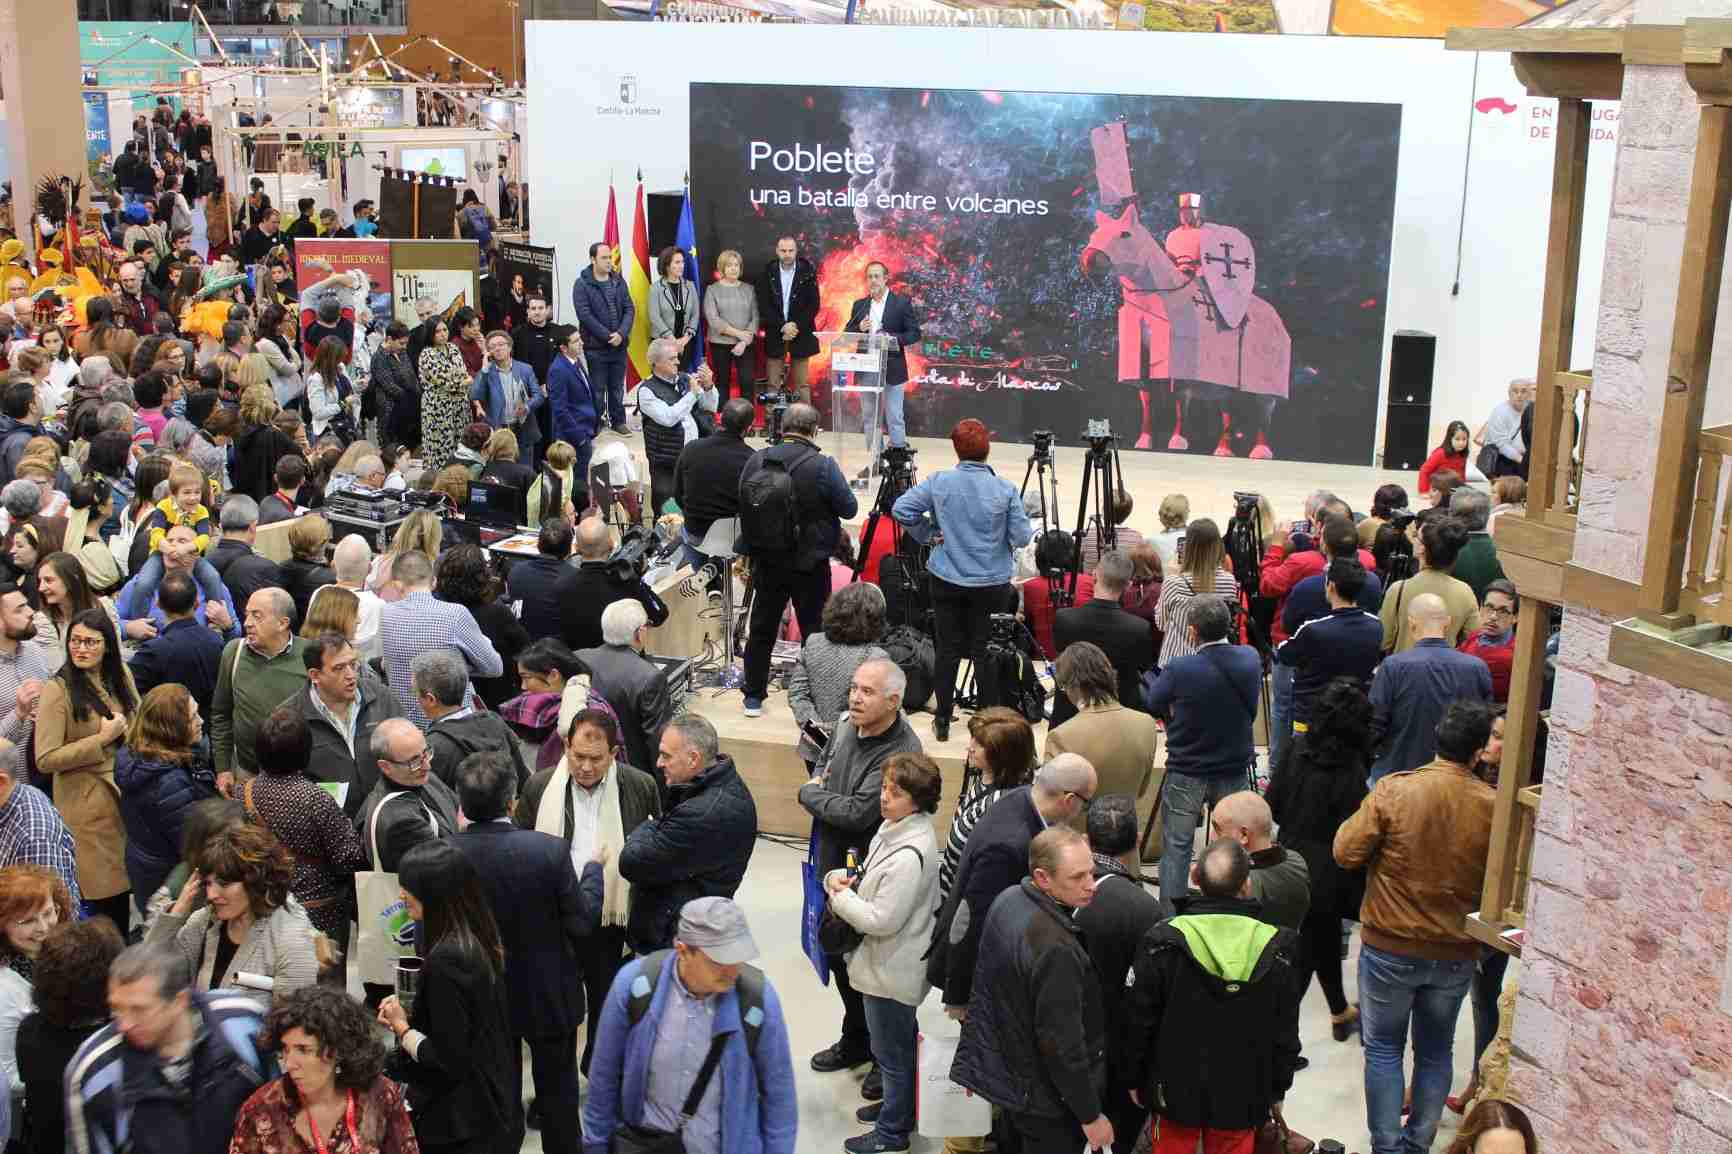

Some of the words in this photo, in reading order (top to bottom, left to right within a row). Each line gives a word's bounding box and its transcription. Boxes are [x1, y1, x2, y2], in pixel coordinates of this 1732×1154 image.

[1531, 107, 1552, 119] EN
[1530, 126, 1550, 138] DE
[1590, 128, 1615, 140] IDA
[750, 141, 876, 175] Poblete
[750, 188, 791, 205] una
[798, 186, 869, 208] batalla
[876, 191, 937, 211] entre
[944, 194, 1050, 216] volcanes
